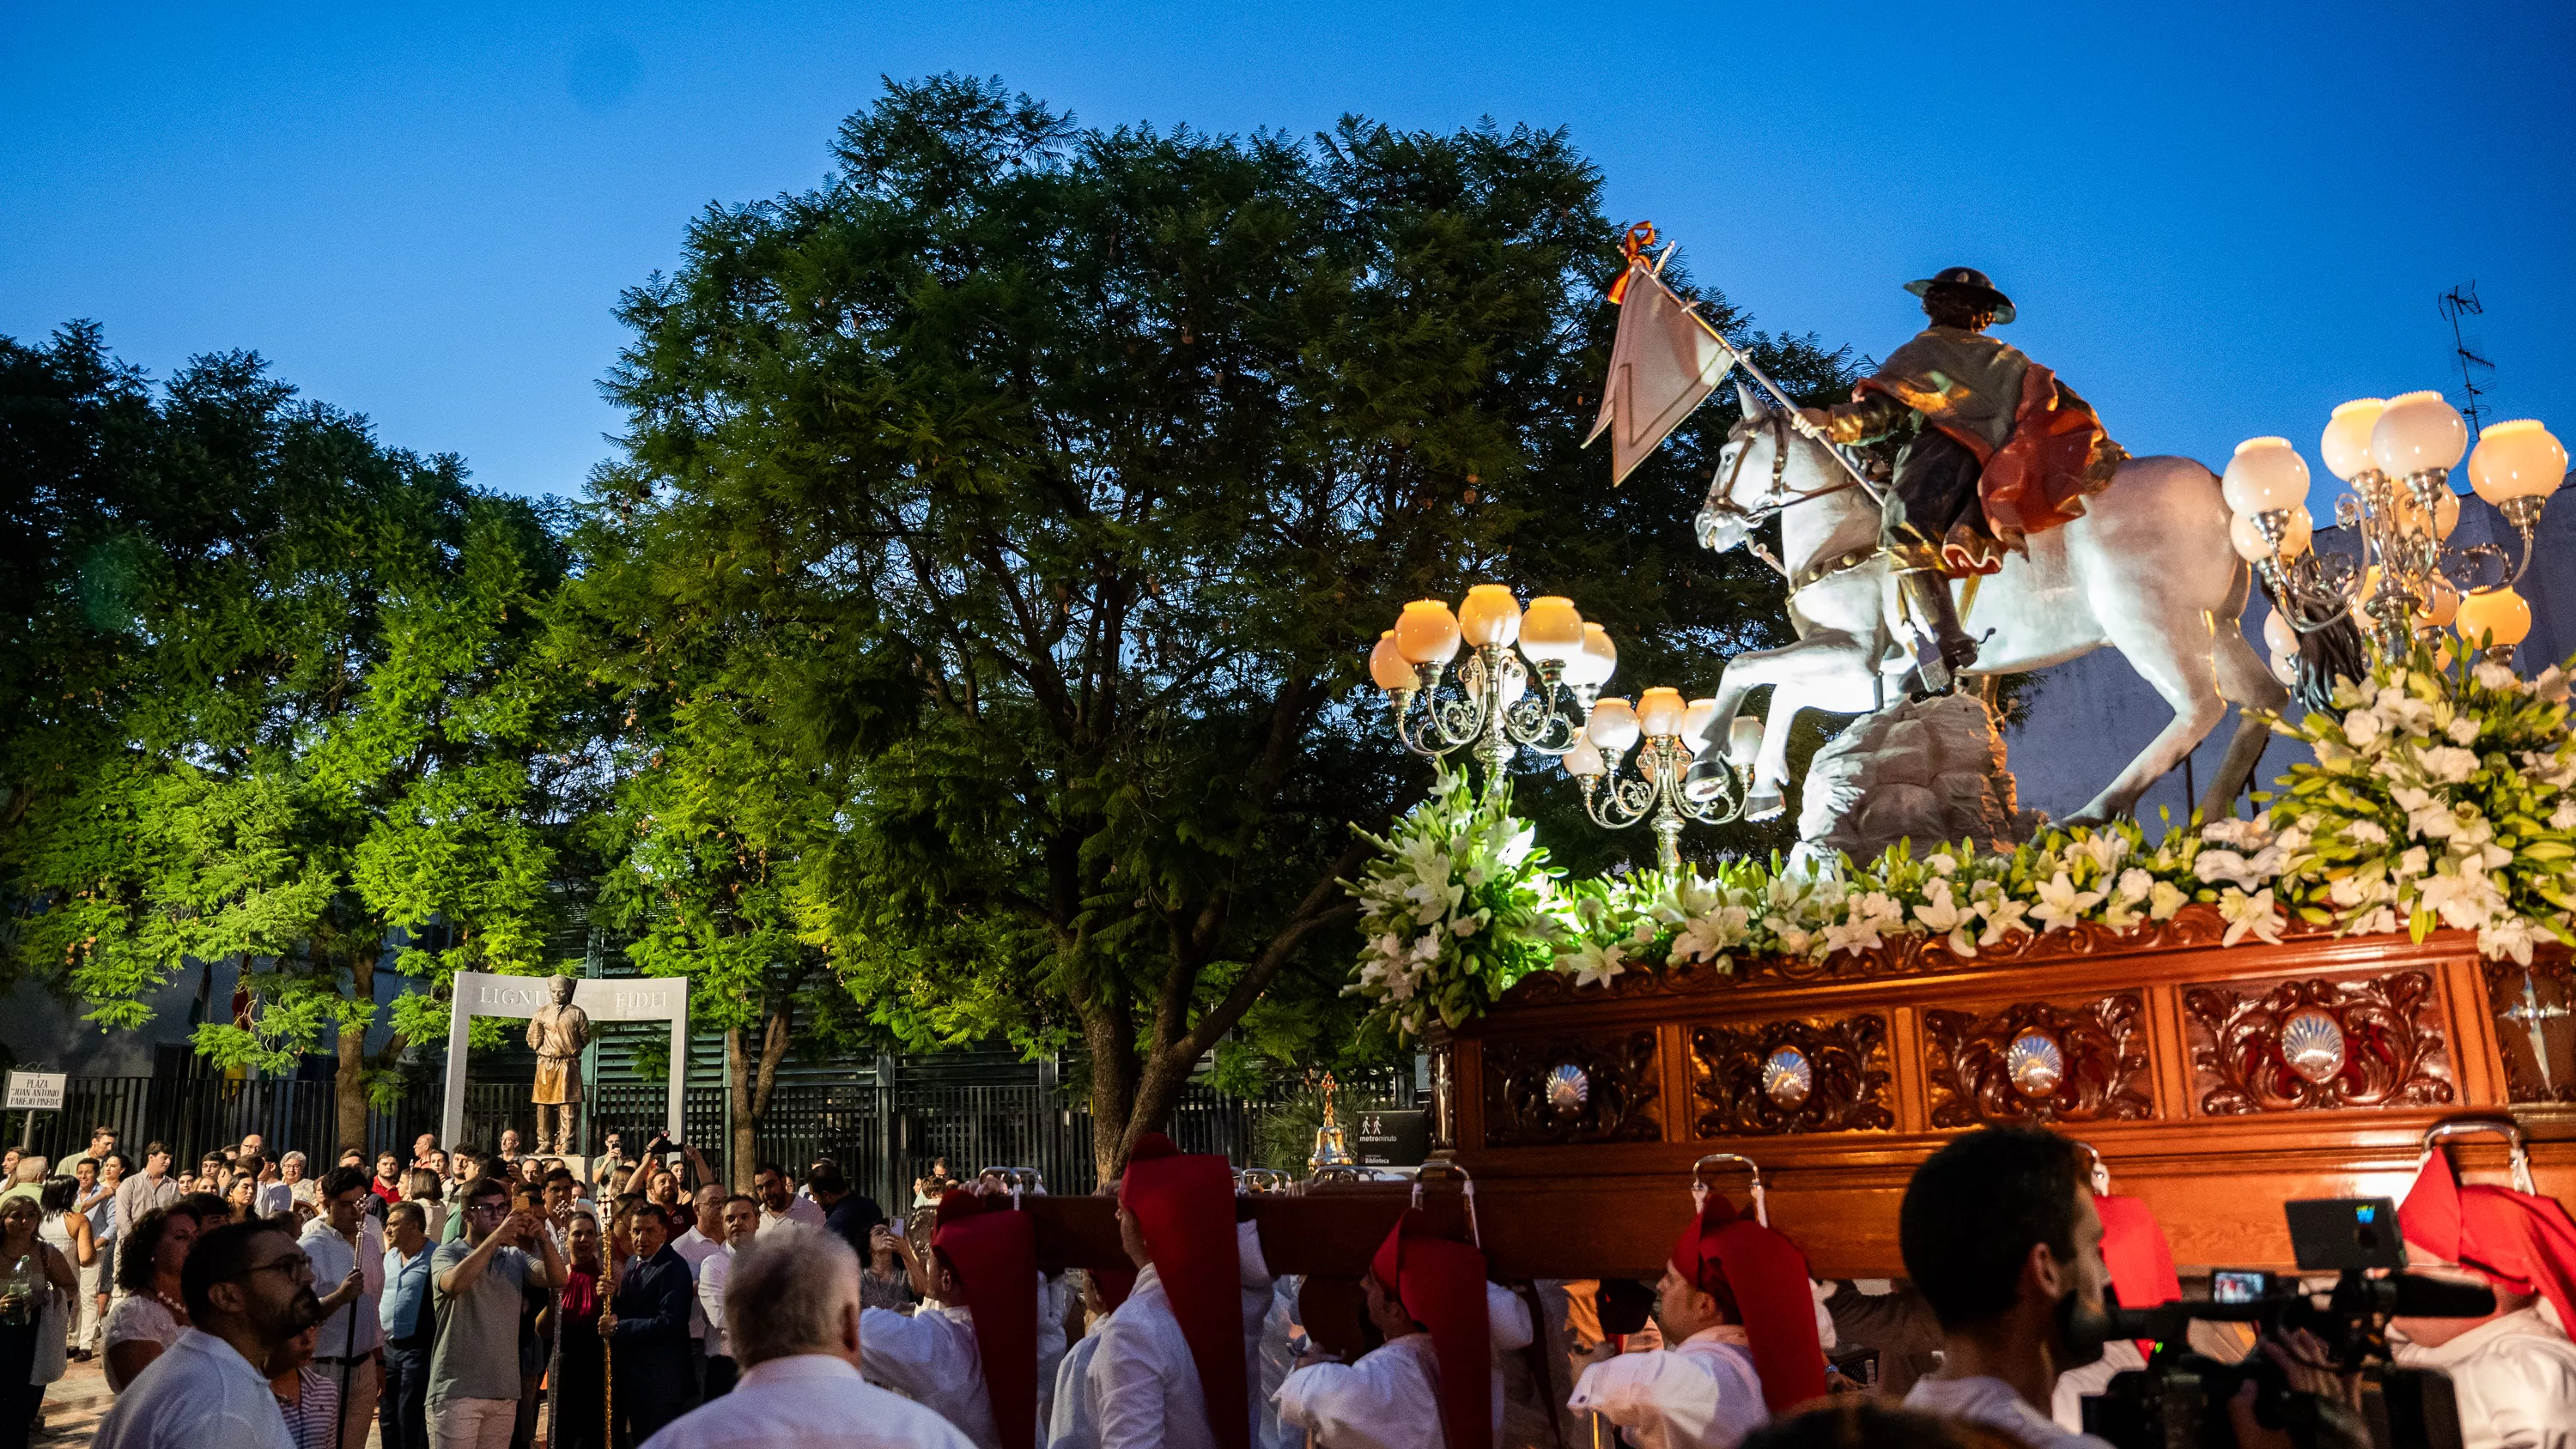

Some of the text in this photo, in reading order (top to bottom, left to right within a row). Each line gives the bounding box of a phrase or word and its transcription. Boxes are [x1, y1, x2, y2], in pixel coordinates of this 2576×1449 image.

[479, 987, 667, 1007] LIGNU FIDEI
[27, 1079, 48, 1088] PLAZA
